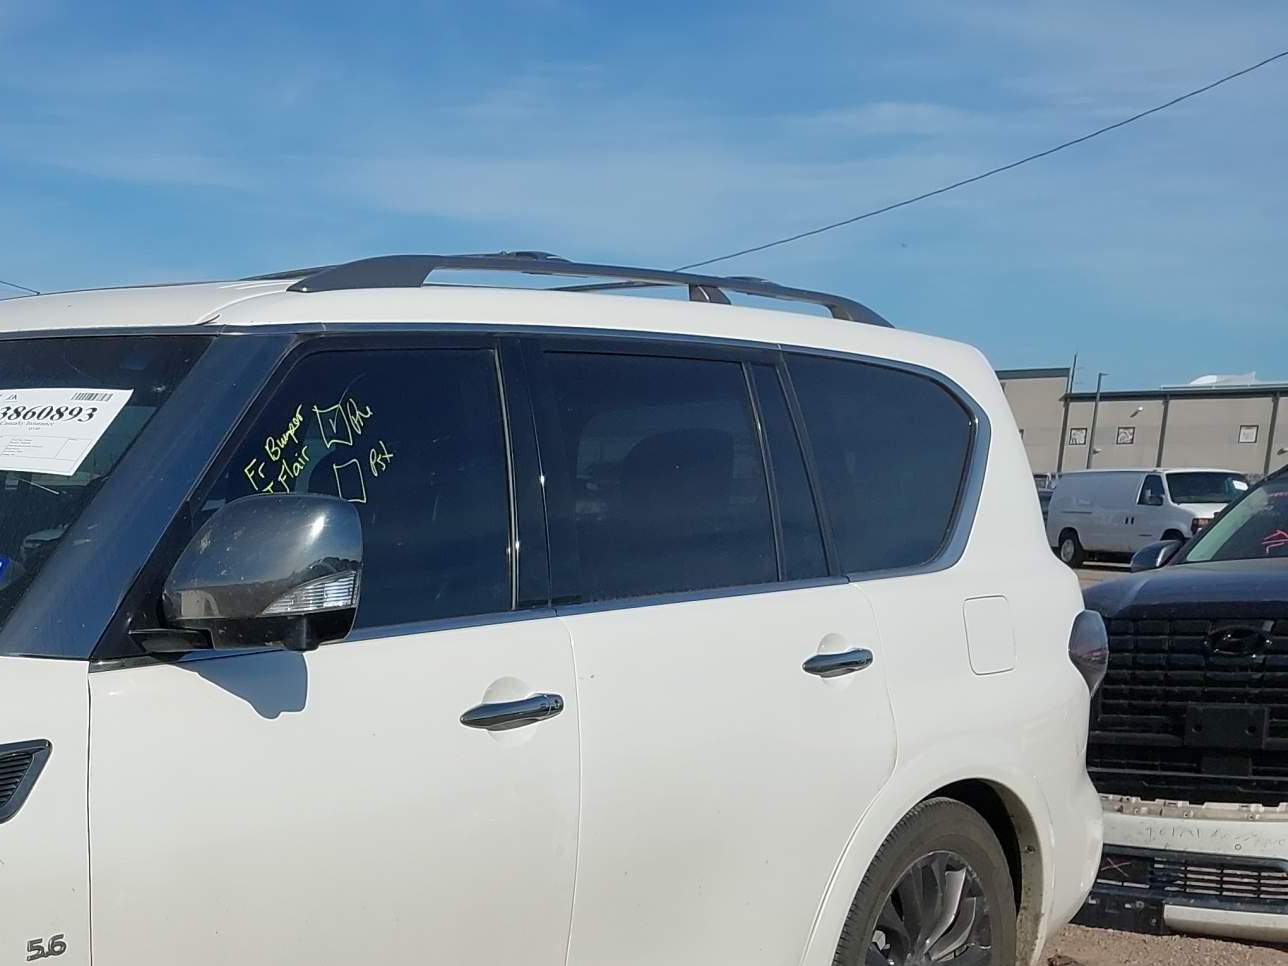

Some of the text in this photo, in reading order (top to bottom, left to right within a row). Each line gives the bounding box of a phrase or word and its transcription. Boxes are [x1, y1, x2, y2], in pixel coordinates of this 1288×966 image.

[264, 403, 303, 461] Bumper
[278, 446, 310, 494] Flair
[26, 933, 67, 961] 5.6
